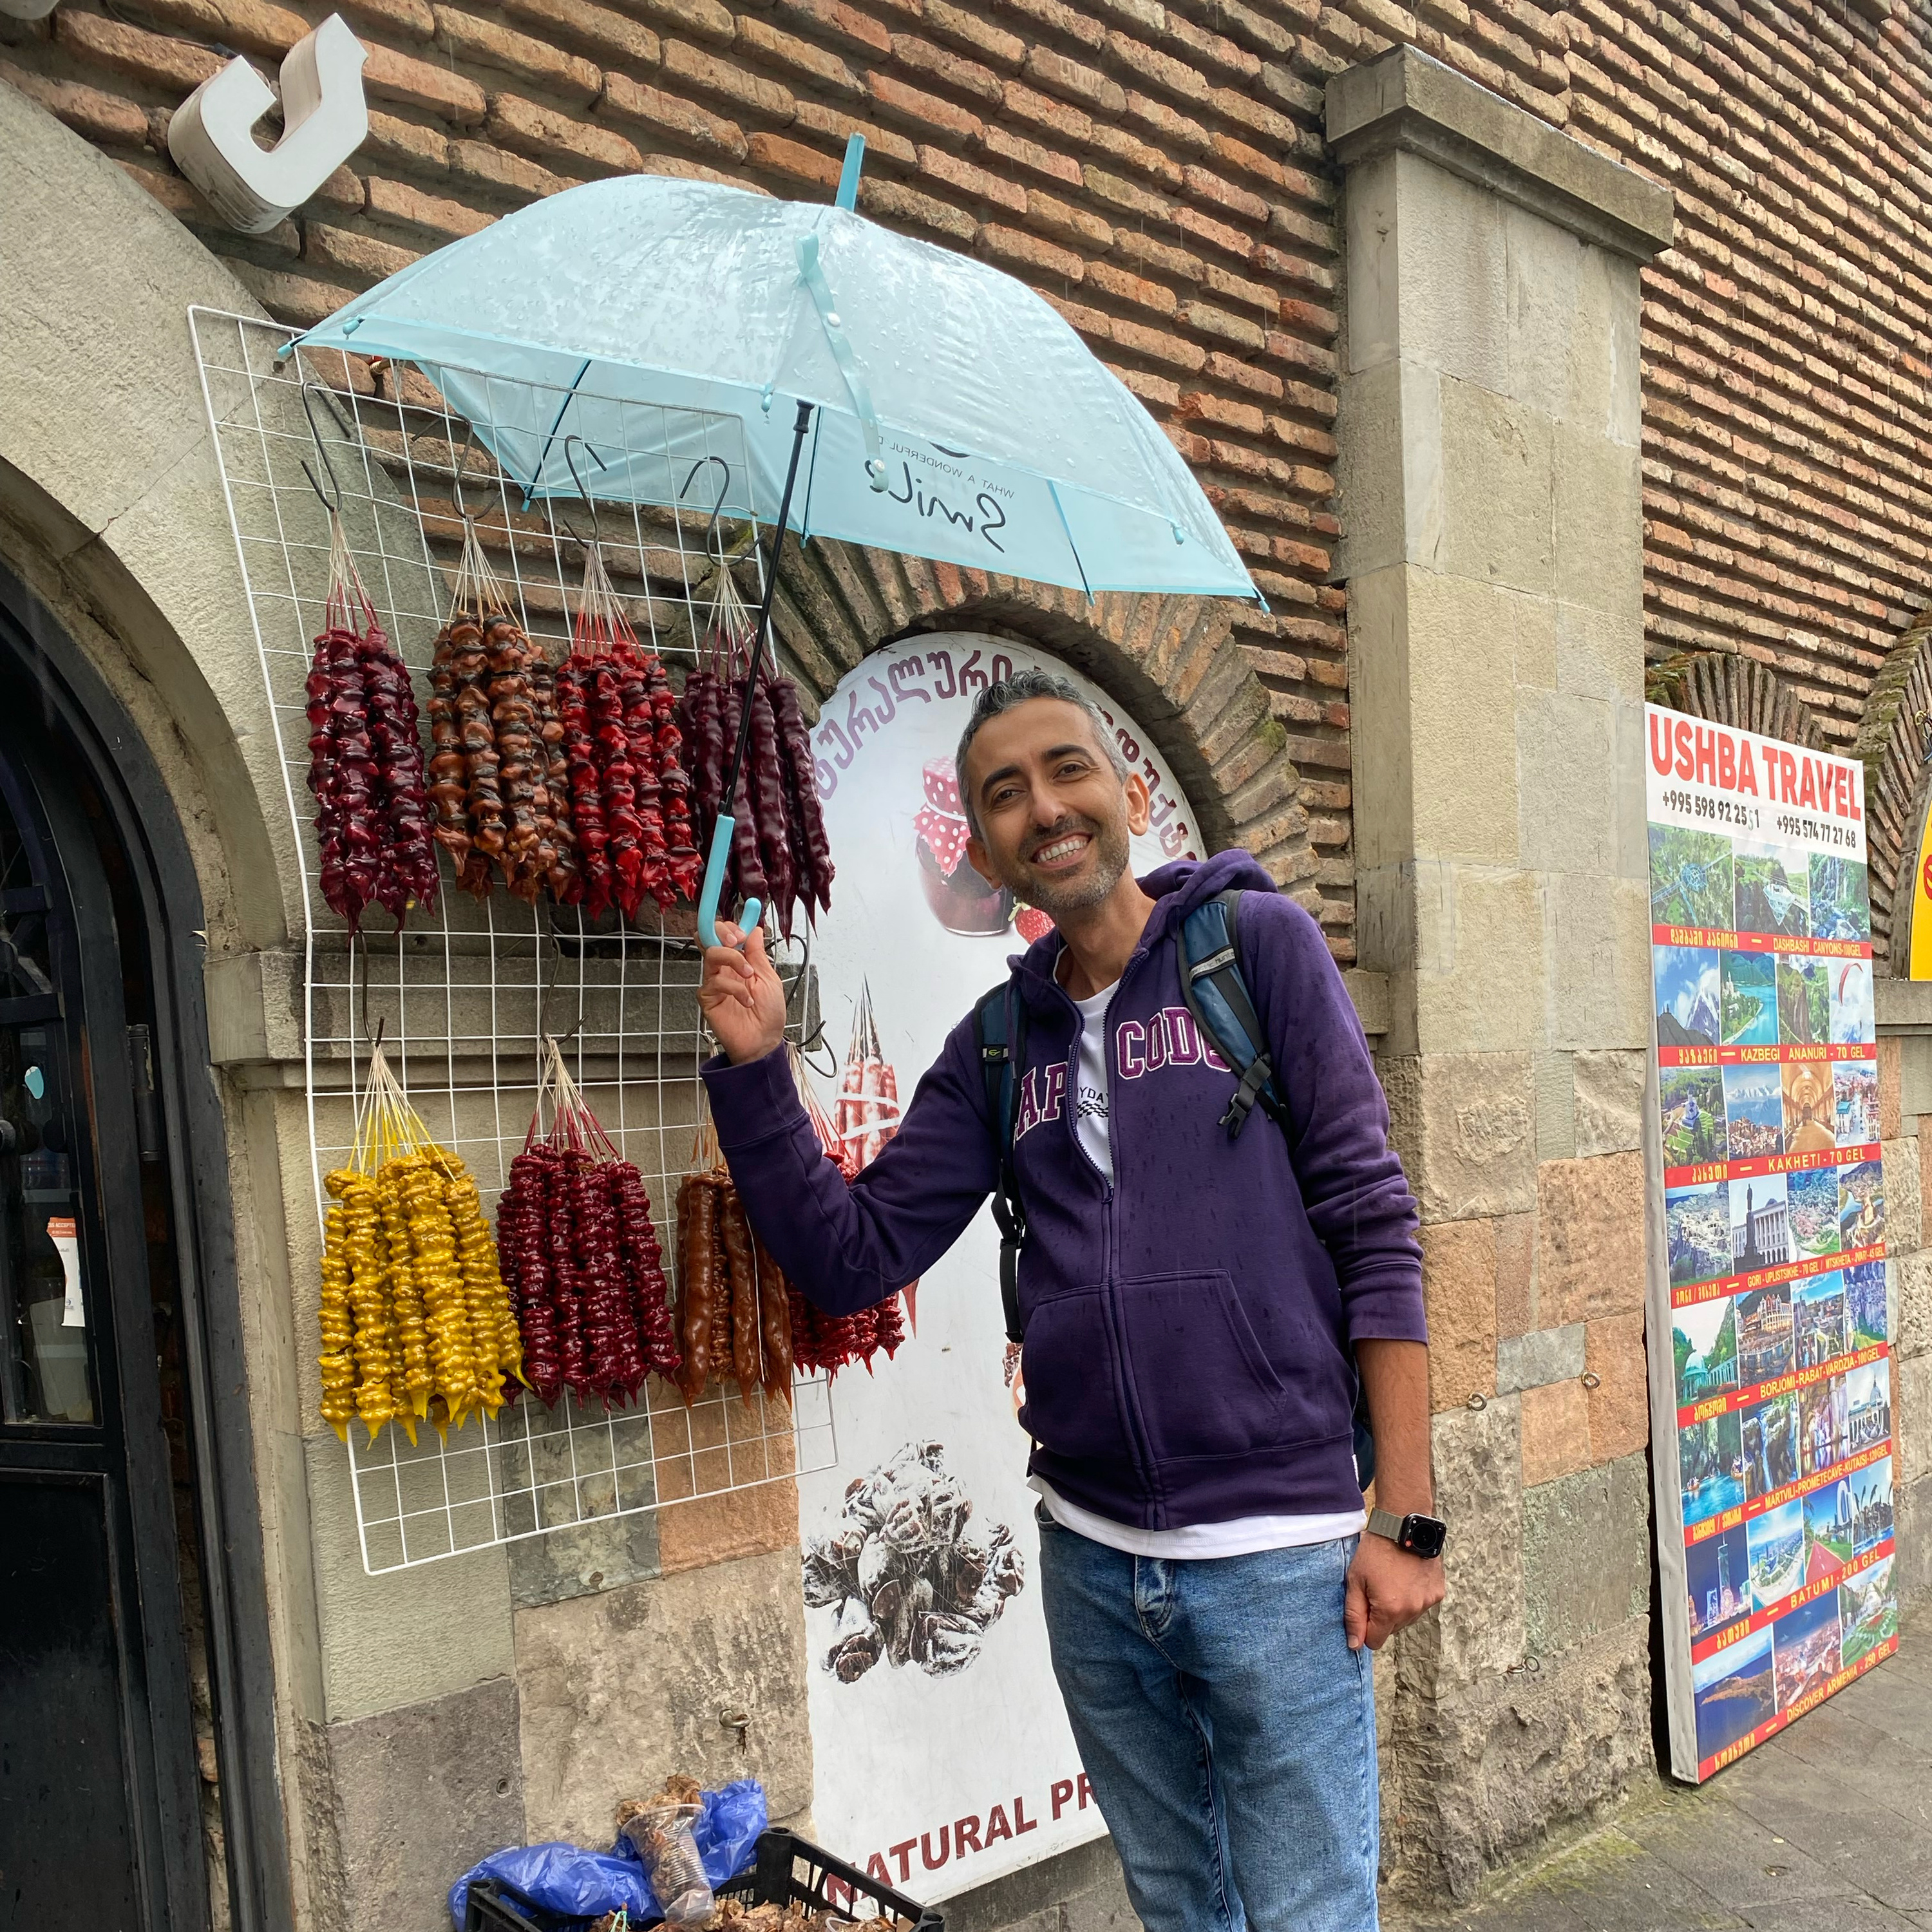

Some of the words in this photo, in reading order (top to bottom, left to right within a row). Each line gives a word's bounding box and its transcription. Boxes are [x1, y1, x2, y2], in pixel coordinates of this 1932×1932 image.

[1650, 713, 1758, 797] USHBA
[1762, 745, 1861, 821] TRAVEL
[1663, 790, 1692, 814] +995
[1695, 795, 1715, 819] 598
[1718, 800, 1732, 822] 92
[1777, 815, 1801, 836] +995
[1803, 819, 1819, 840] 574
[1821, 823, 1830, 842] 77
[1833, 826, 1842, 845] 27
[1845, 829, 1856, 848] 68
[1774, 937, 1810, 952] DASHBASHI
[1741, 1047, 1780, 1062] KAZBEGI
[1788, 1047, 1827, 1060] ANANURI
[1837, 1046, 1847, 1059] 70
[1850, 1046, 1866, 1058] GEL
[1014, 1061, 1068, 1142] AP
[1079, 1086, 1108, 1104] YDA
[1692, 1164, 1728, 1184] კახეთი
[1768, 1153, 1821, 1172] KAKHETI
[1830, 1151, 1842, 1164] 70
[1846, 1148, 1866, 1162] GEL
[1747, 1274, 1761, 1288] GORI
[1809, 1262, 1819, 1273] GEL
[1875, 1245, 1884, 1257] GEL
[1694, 1397, 1727, 1421] ბორჯომი
[1791, 1575, 1833, 1609] BATUMI
[1842, 1560, 1858, 1580] 200
[1862, 1551, 1880, 1567] GEL
[1717, 1619, 1750, 1649] ბათუმი
[1786, 1687, 1824, 1722] DISCOVER
[1827, 1665, 1857, 1694] ARMENIA
[1864, 1654, 1876, 1671] 250
[1878, 1645, 1891, 1661] GEL
